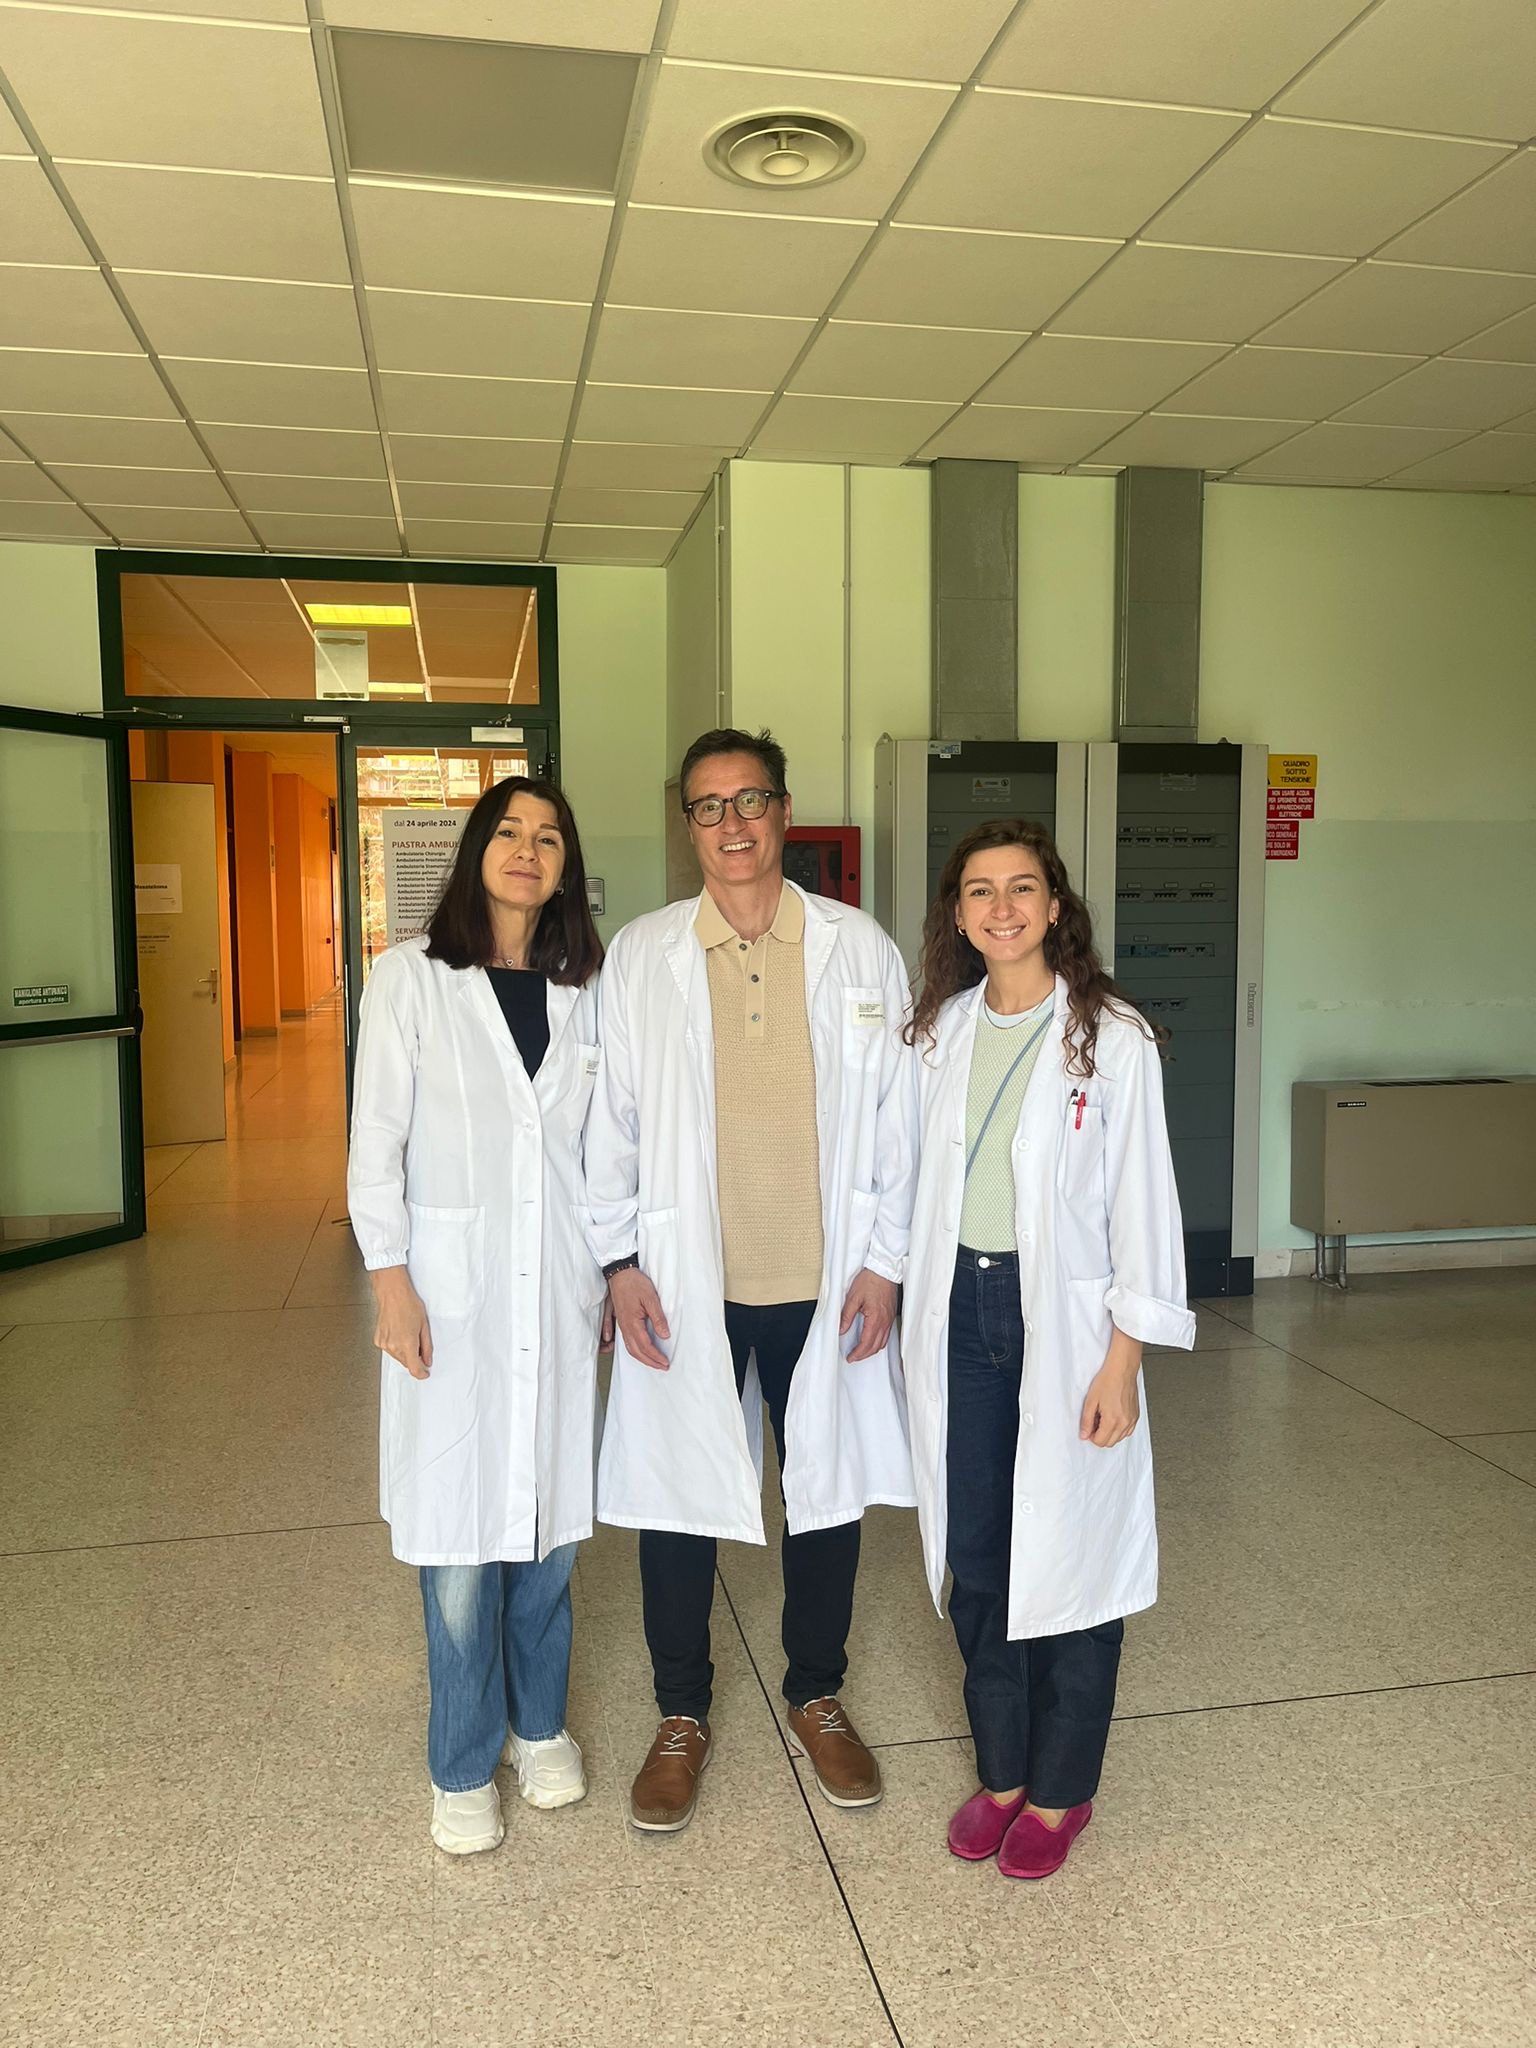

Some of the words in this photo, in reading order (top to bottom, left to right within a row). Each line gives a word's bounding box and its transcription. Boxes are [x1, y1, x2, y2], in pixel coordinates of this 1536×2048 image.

[417, 820, 438, 828] aprile
[15, 988, 42, 997] MANIGLIONE
[43, 986, 67, 996] ANTIPANICO
